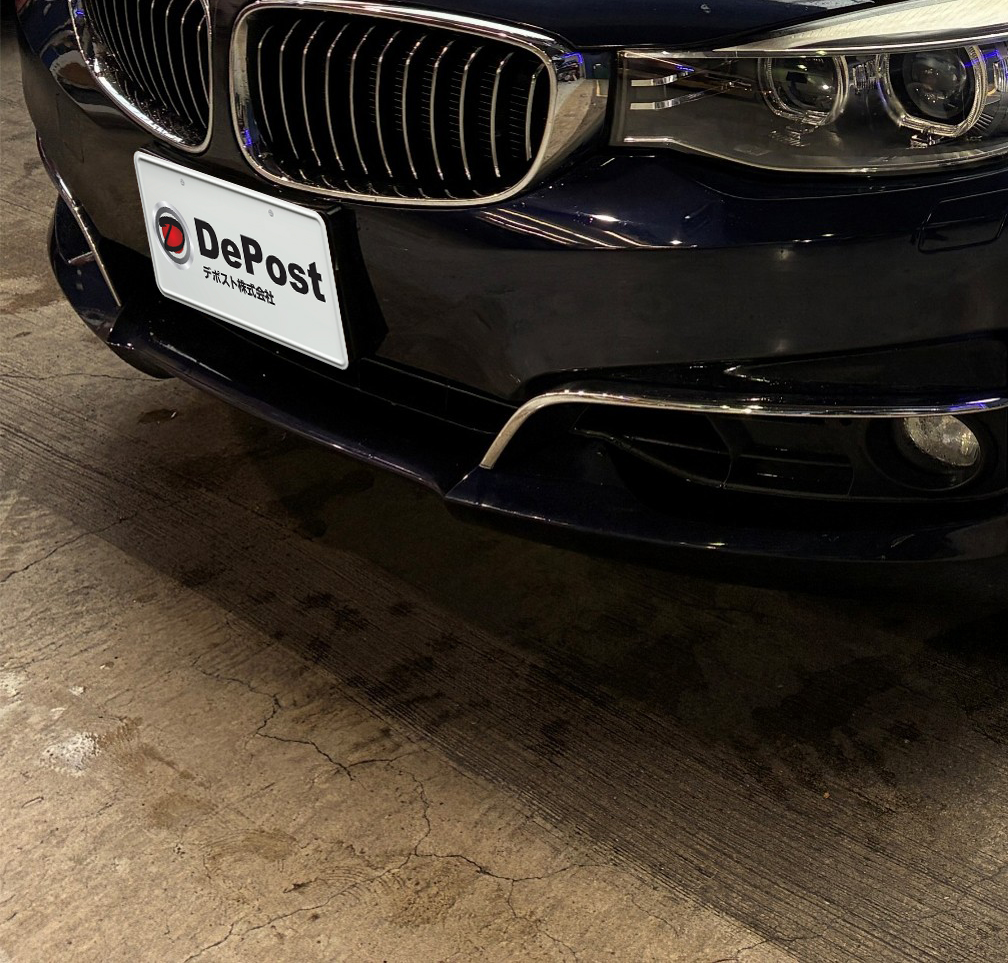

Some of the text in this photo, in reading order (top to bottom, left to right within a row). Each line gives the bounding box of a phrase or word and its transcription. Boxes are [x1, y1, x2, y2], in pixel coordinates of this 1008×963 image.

[194, 217, 326, 303] DePost
[202, 265, 276, 306] デポスト株式会社
